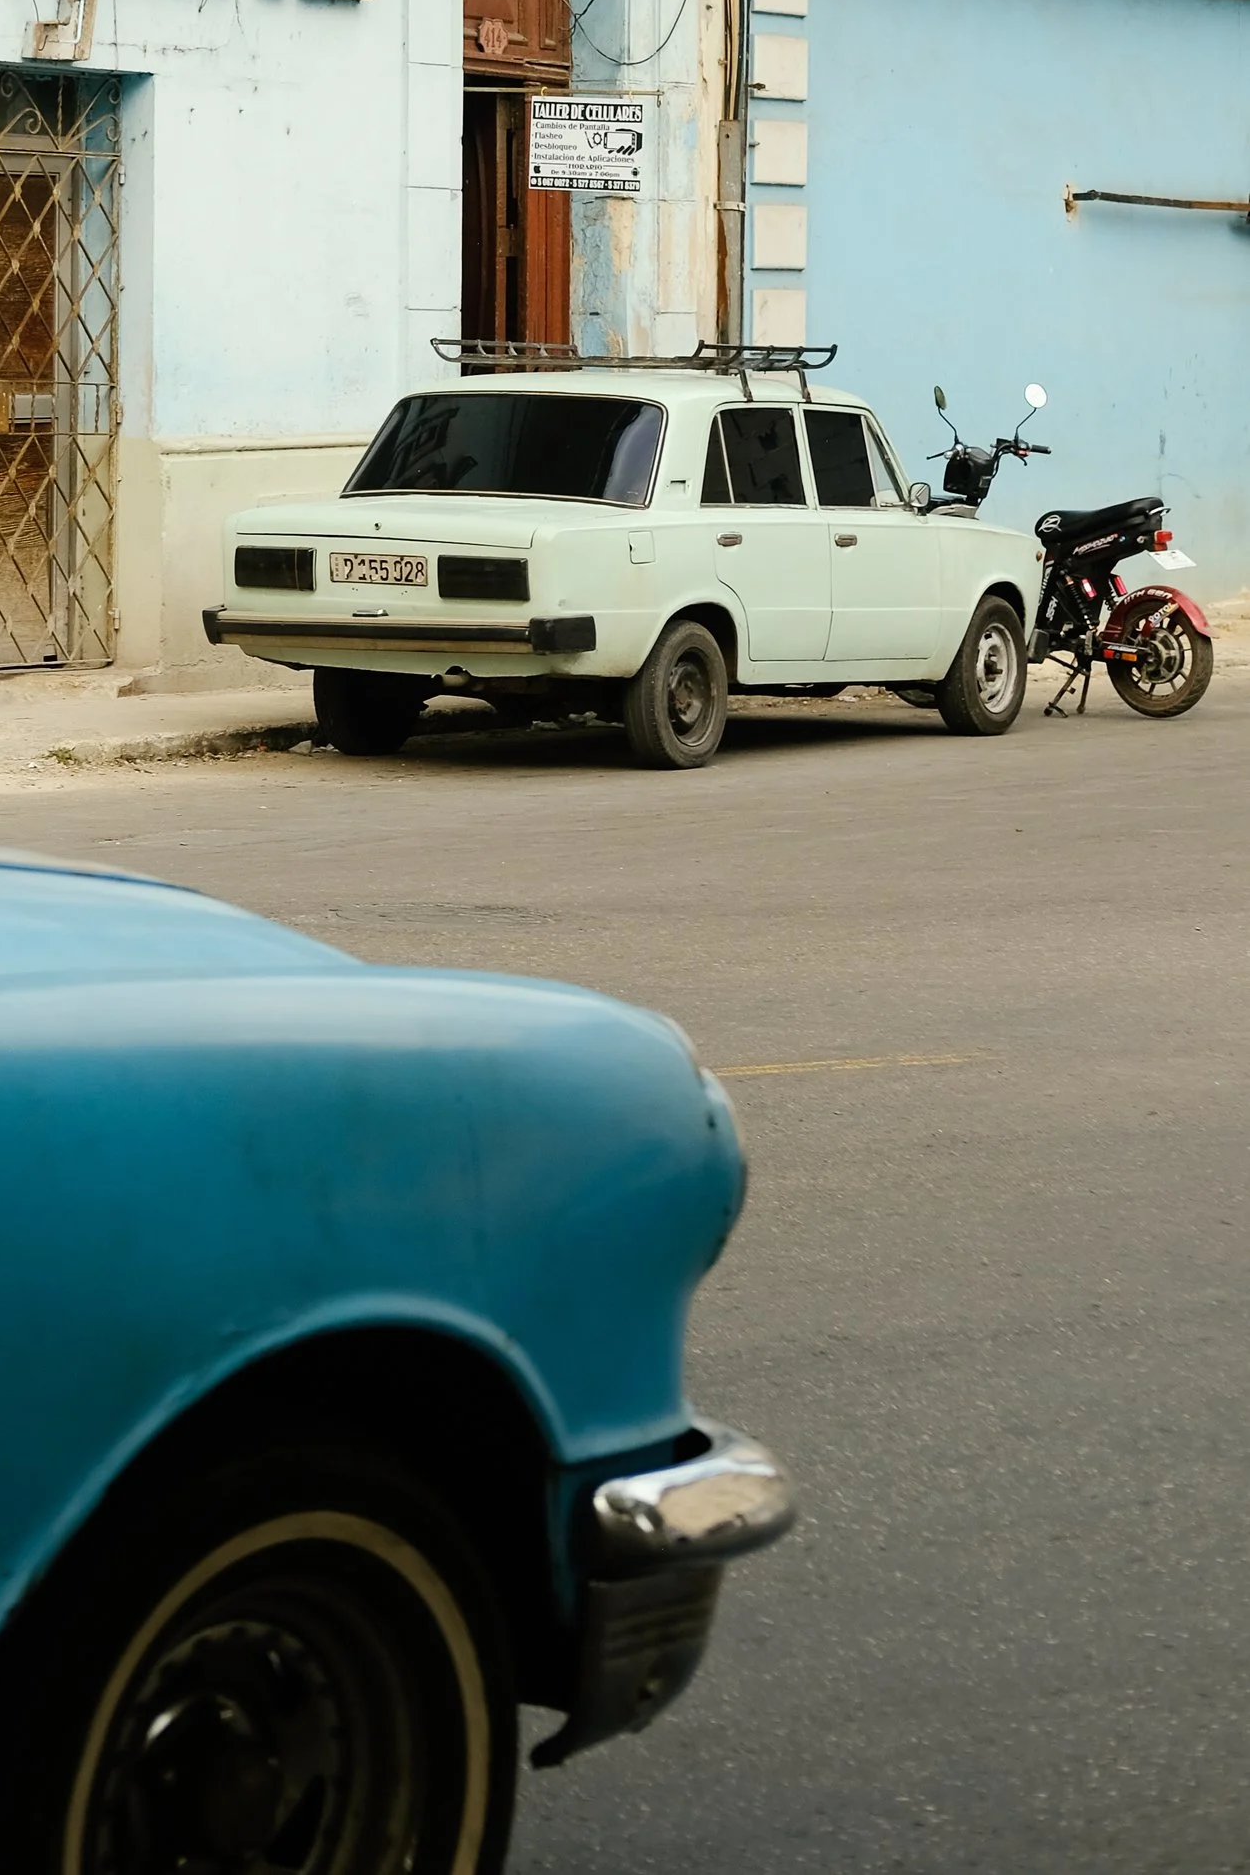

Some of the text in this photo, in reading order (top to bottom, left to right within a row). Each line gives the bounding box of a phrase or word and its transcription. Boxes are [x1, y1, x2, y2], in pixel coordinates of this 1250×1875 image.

[534, 103, 642, 122] TALLER DE CELULARES
[535, 121, 610, 131] Cambios de Pantalla
[534, 132, 563, 140] Flasheo
[534, 142, 578, 152] Desbloqueo
[576, 153, 586, 162] de
[587, 154, 635, 164] Aplicaciones
